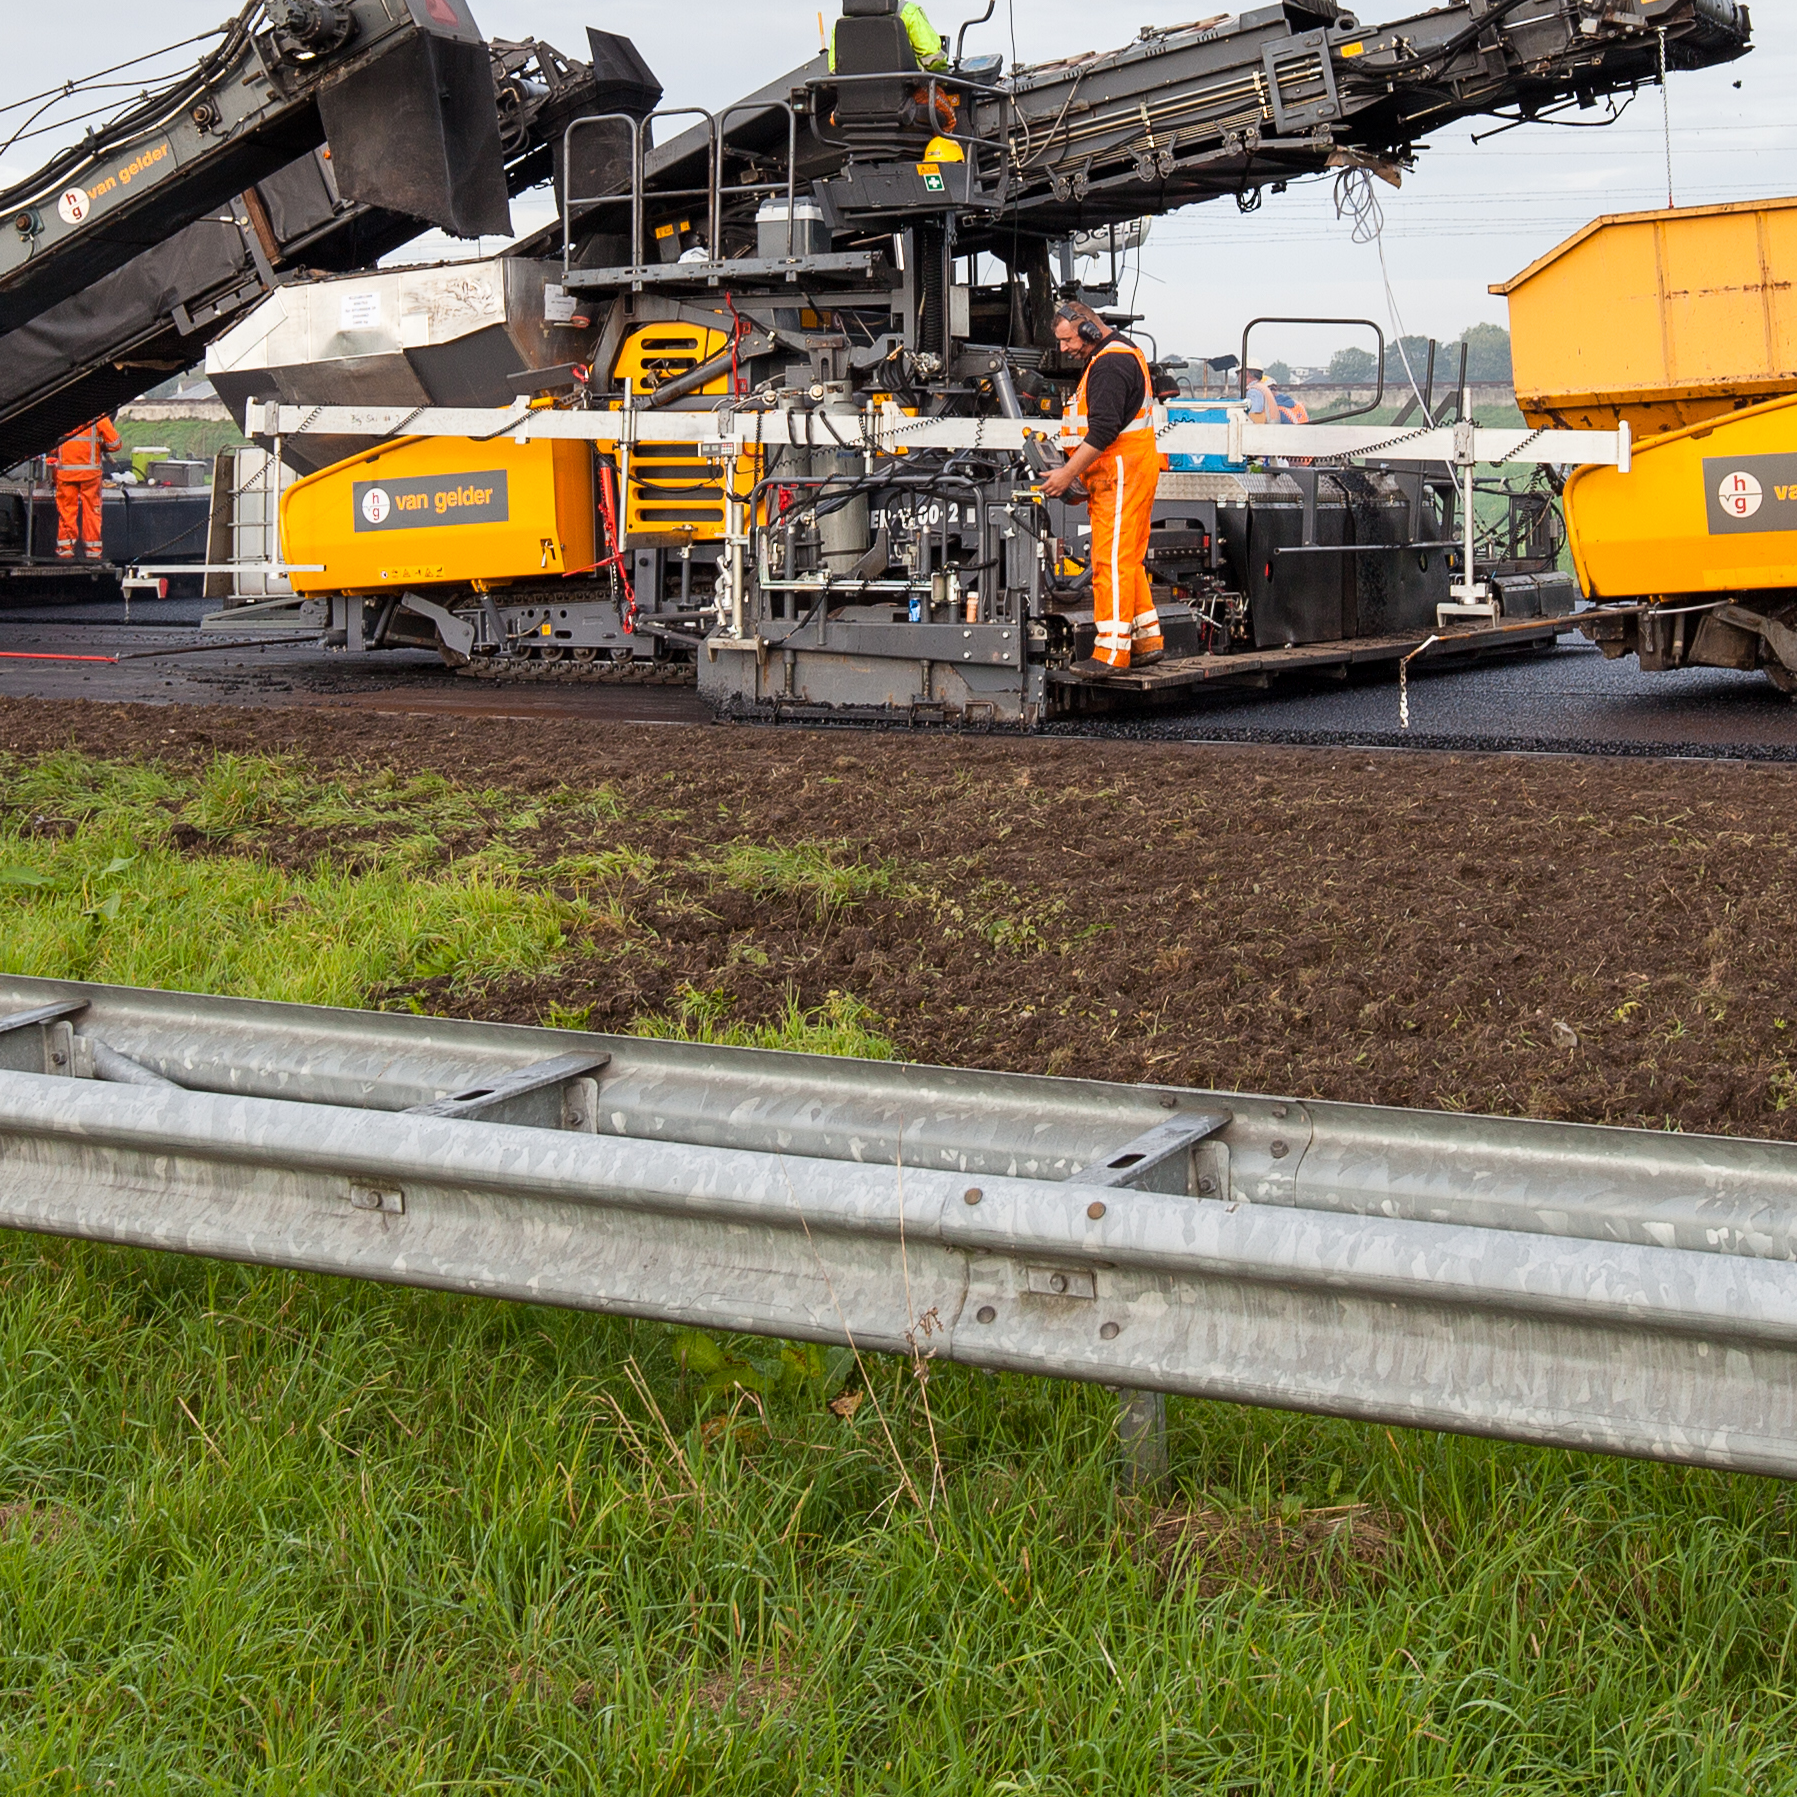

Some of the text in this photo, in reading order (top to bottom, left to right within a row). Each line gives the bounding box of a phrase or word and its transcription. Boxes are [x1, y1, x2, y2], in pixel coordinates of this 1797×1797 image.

[87, 143, 168, 199] van gelder
[65, 193, 77, 205] h
[72, 206, 82, 220] g
[1734, 475, 1746, 491] h
[372, 492, 379, 504] h
[395, 485, 493, 514] van gelder
[1734, 497, 1747, 514] g
[372, 508, 380, 520] g
